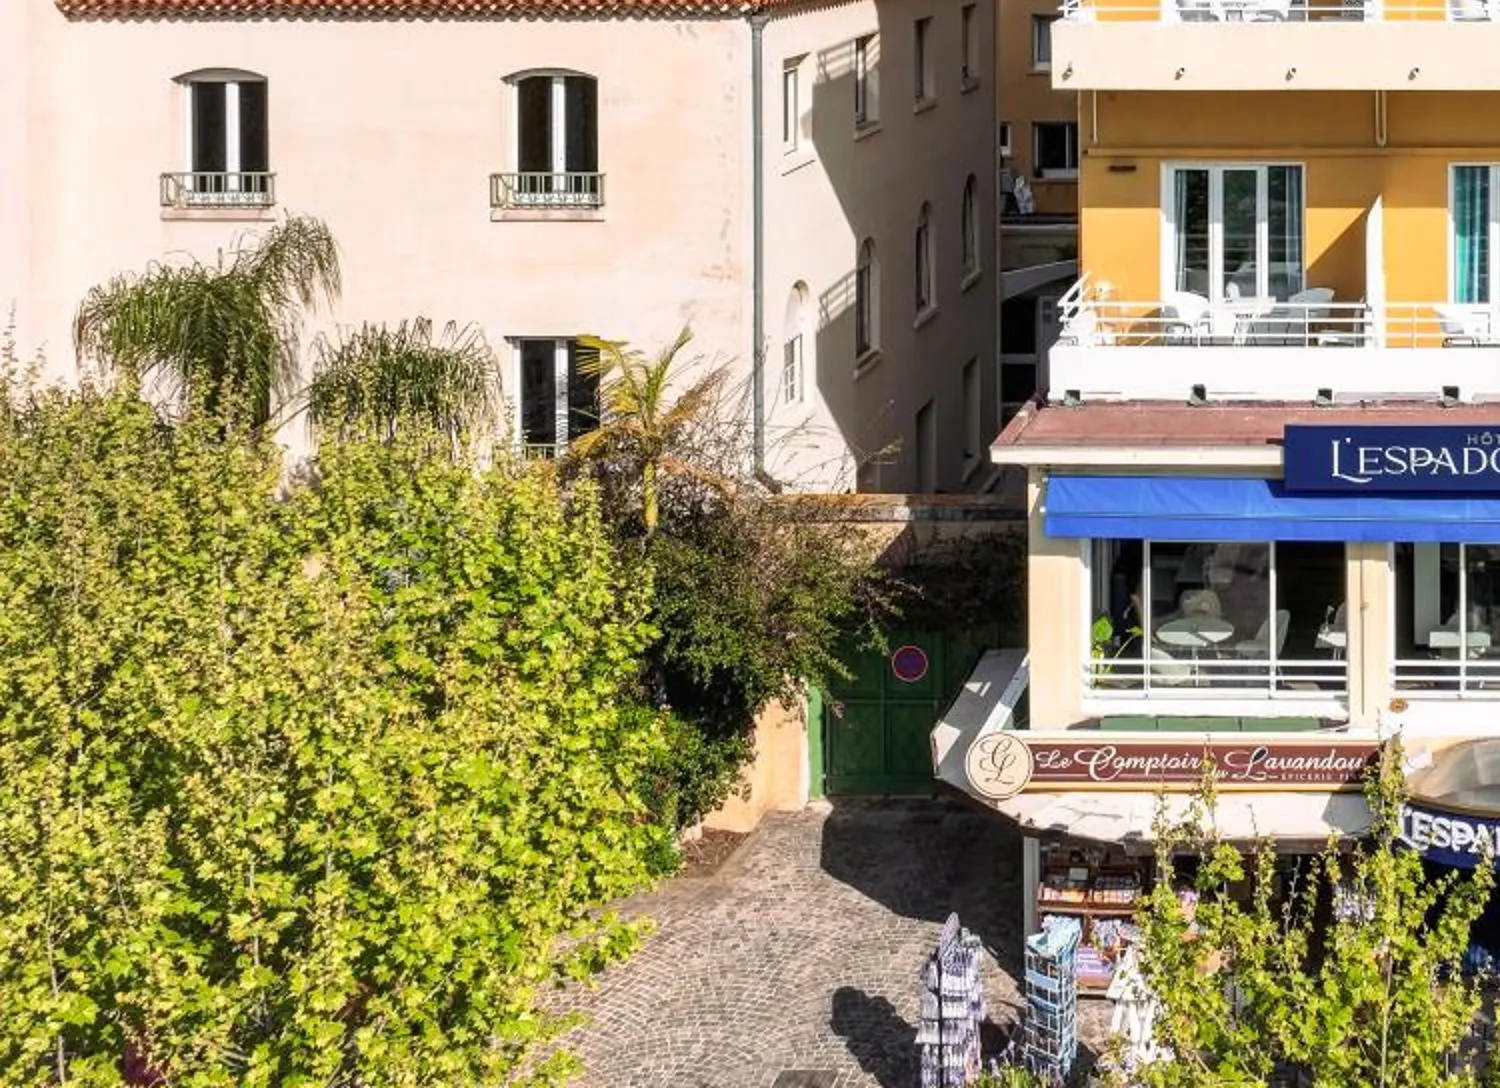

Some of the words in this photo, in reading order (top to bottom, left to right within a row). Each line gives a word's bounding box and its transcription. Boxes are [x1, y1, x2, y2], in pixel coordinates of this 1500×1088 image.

[1035, 748, 1073, 769] Le
[1073, 745, 1203, 781] Comptoir
[1223, 745, 1367, 781] Lavandou
